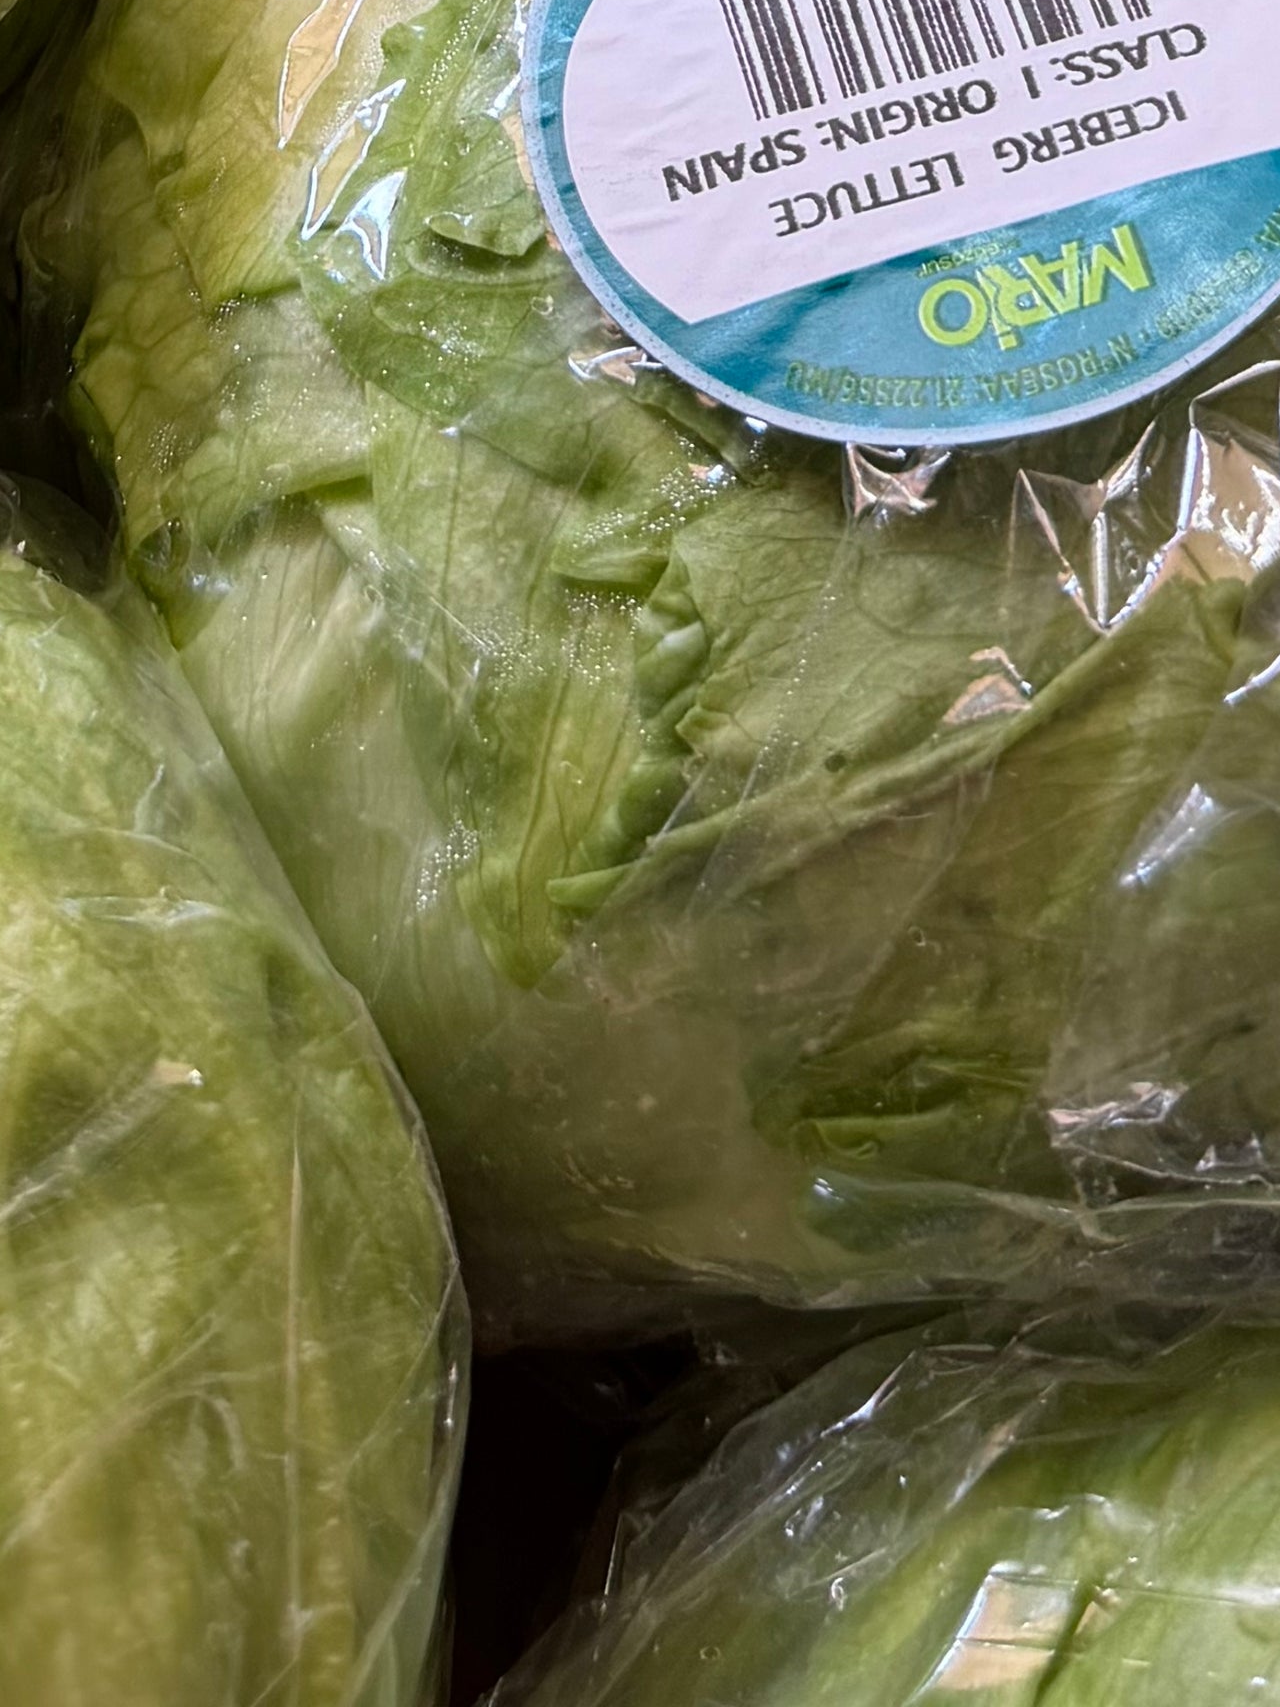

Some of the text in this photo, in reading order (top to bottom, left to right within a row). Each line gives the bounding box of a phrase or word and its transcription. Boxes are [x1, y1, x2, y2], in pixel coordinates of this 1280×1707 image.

[662, 23, 1206, 201] CLASS: I ORIGIN: SPAIN
[768, 90, 1186, 236] ICEBERG LETTUCE
